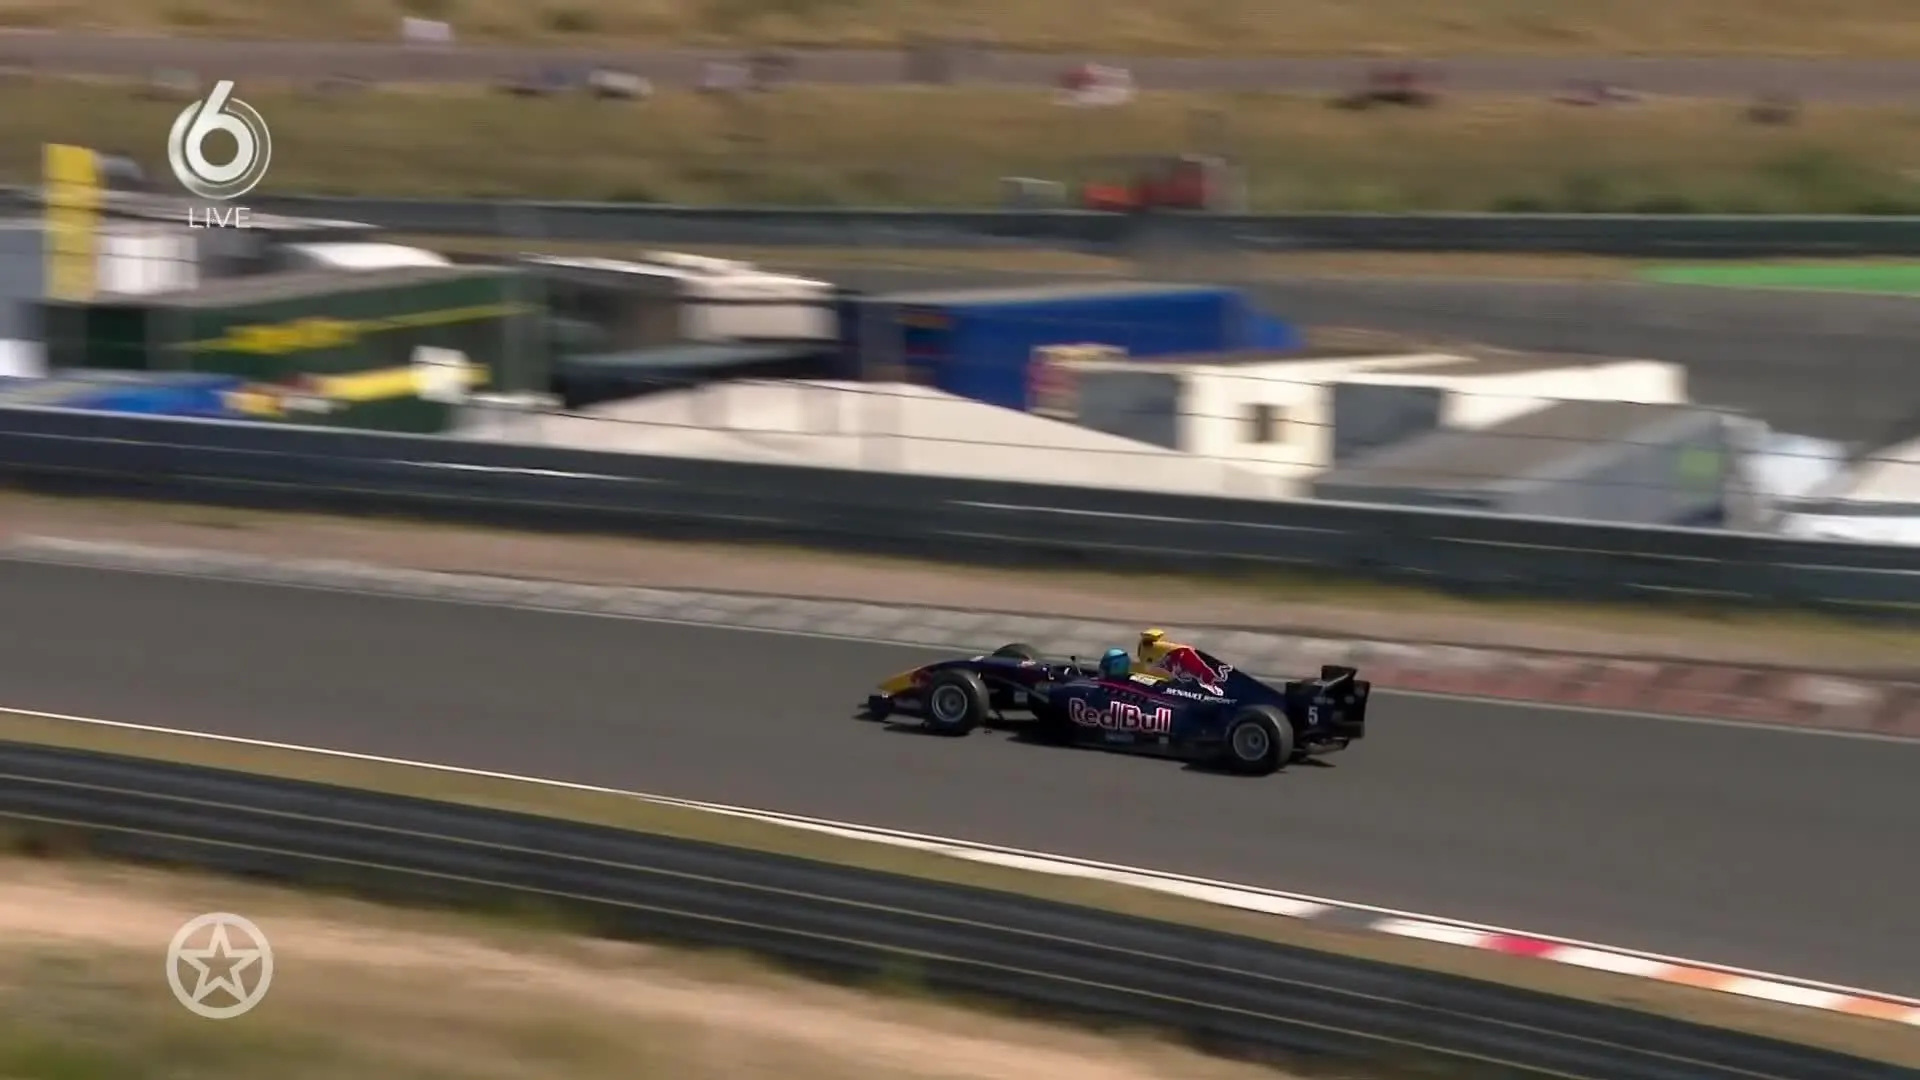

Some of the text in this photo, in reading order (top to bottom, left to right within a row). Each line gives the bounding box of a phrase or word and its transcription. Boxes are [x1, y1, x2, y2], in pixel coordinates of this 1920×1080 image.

[1069, 697, 1171, 733] Red Bull
[1308, 706, 1318, 724] 5
